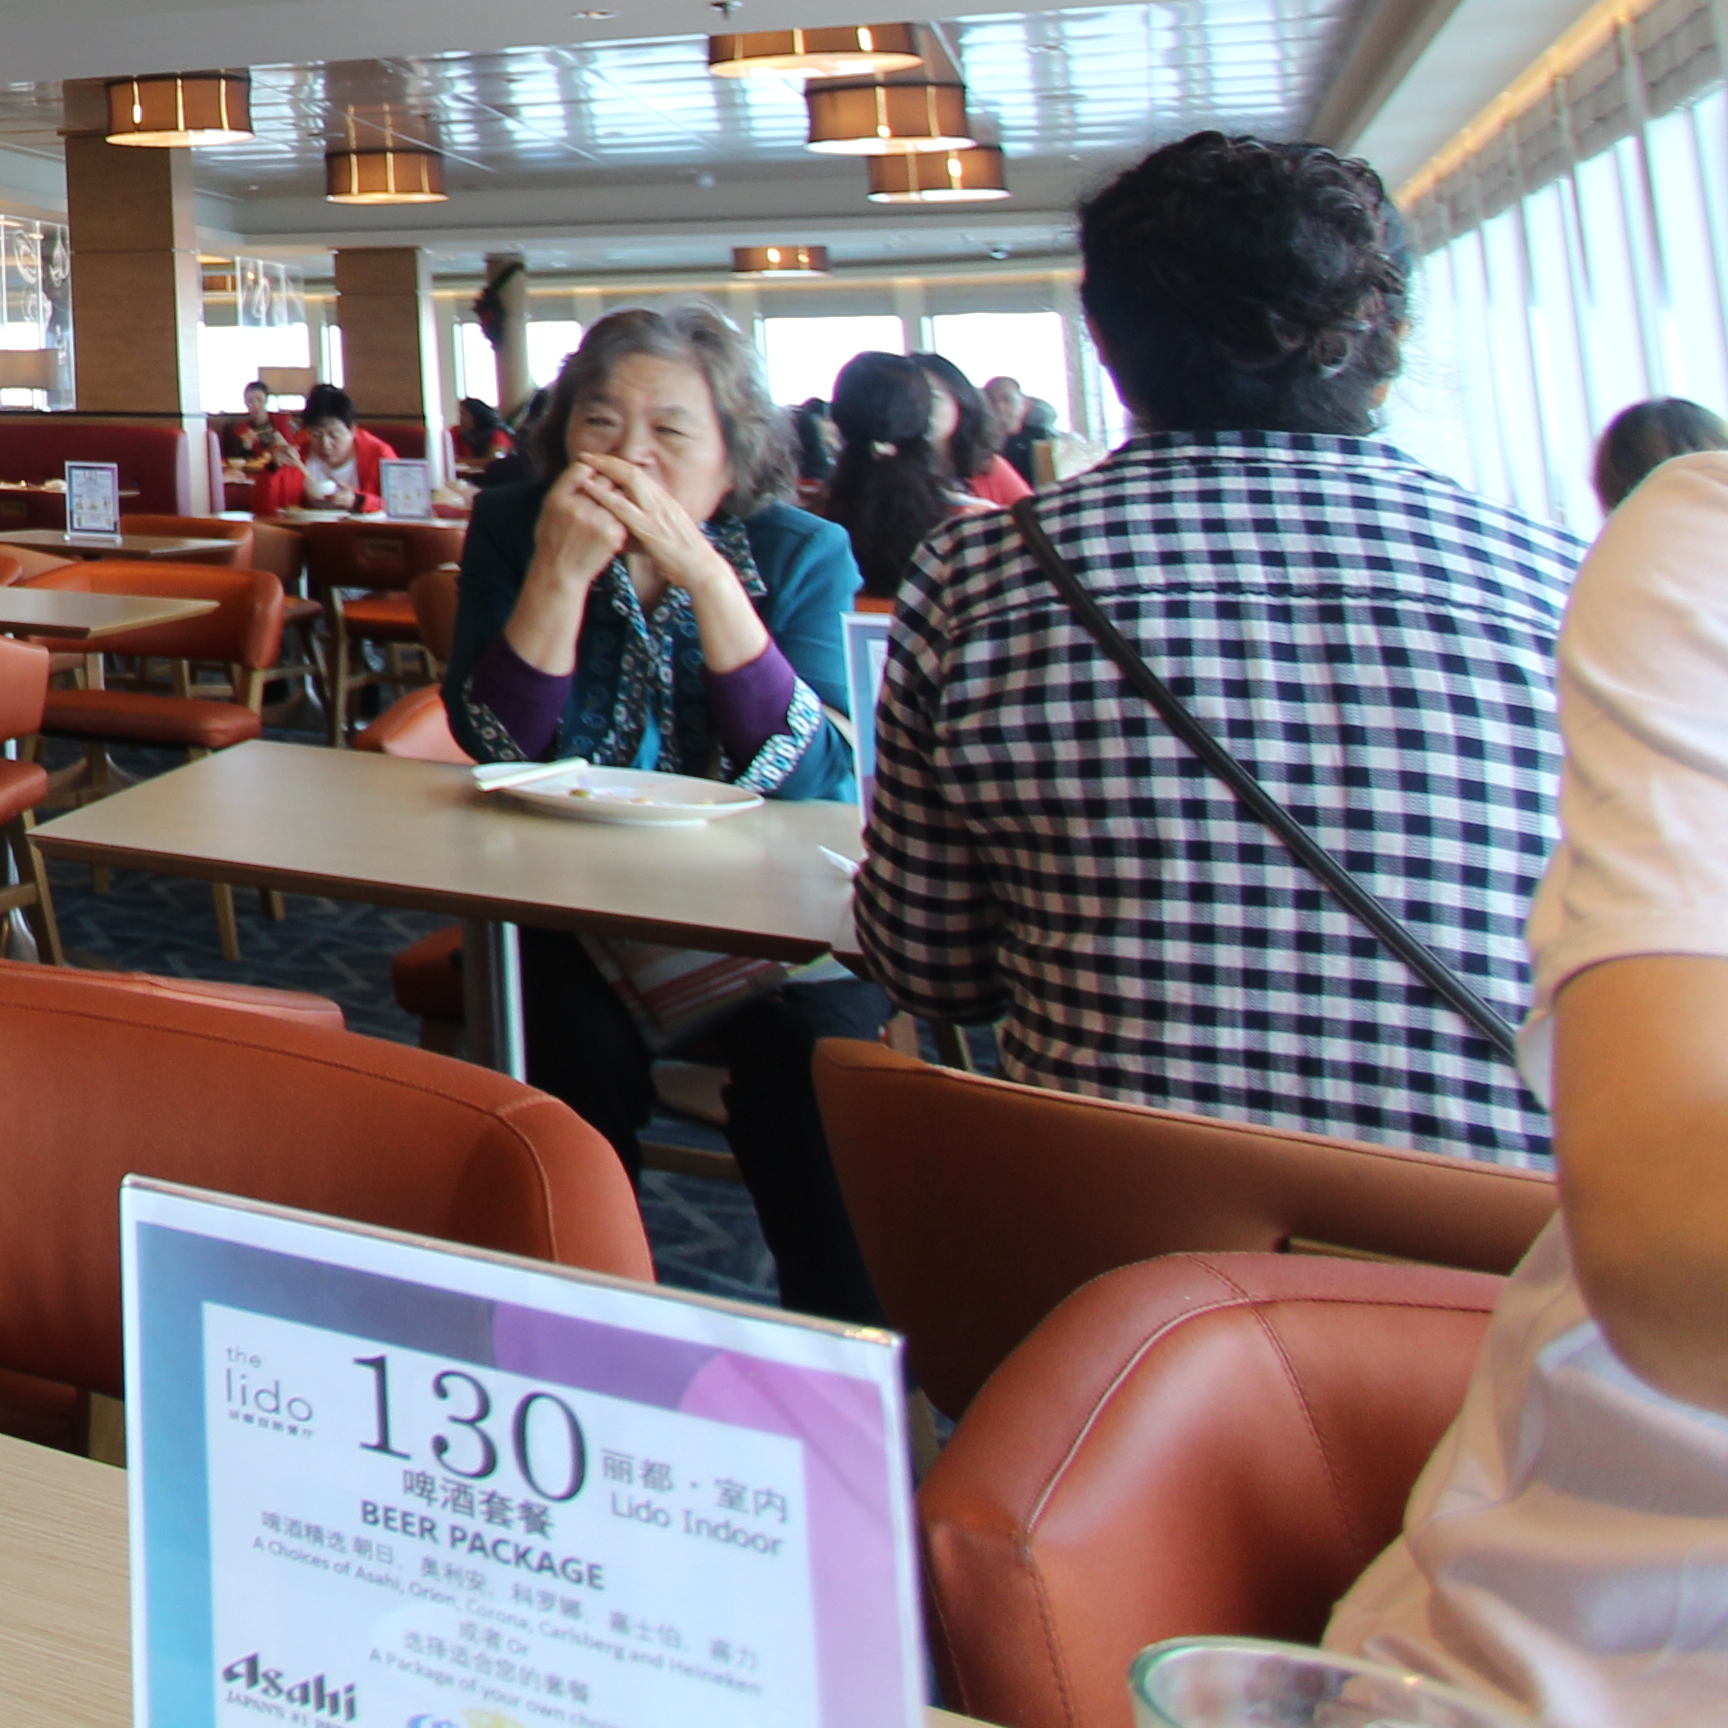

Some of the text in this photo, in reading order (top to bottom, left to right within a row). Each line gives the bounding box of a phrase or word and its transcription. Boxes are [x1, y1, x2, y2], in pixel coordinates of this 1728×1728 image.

[226, 1345, 262, 1368] the
[226, 1367, 313, 1422] lido
[352, 1354, 587, 1504] 130
[401, 1468, 553, 1539] 啤酒套餐
[610, 1490, 784, 1557] Lido Indoor
[253, 1535, 265, 1552] A
[268, 1540, 330, 1571] Choices
[332, 1560, 351, 1575] of
[360, 1498, 606, 1592] BEER PACKAGE
[222, 1651, 357, 1723] Asahi
[369, 1647, 382, 1663] A
[385, 1651, 455, 1687] Package
[458, 1677, 477, 1693] of
